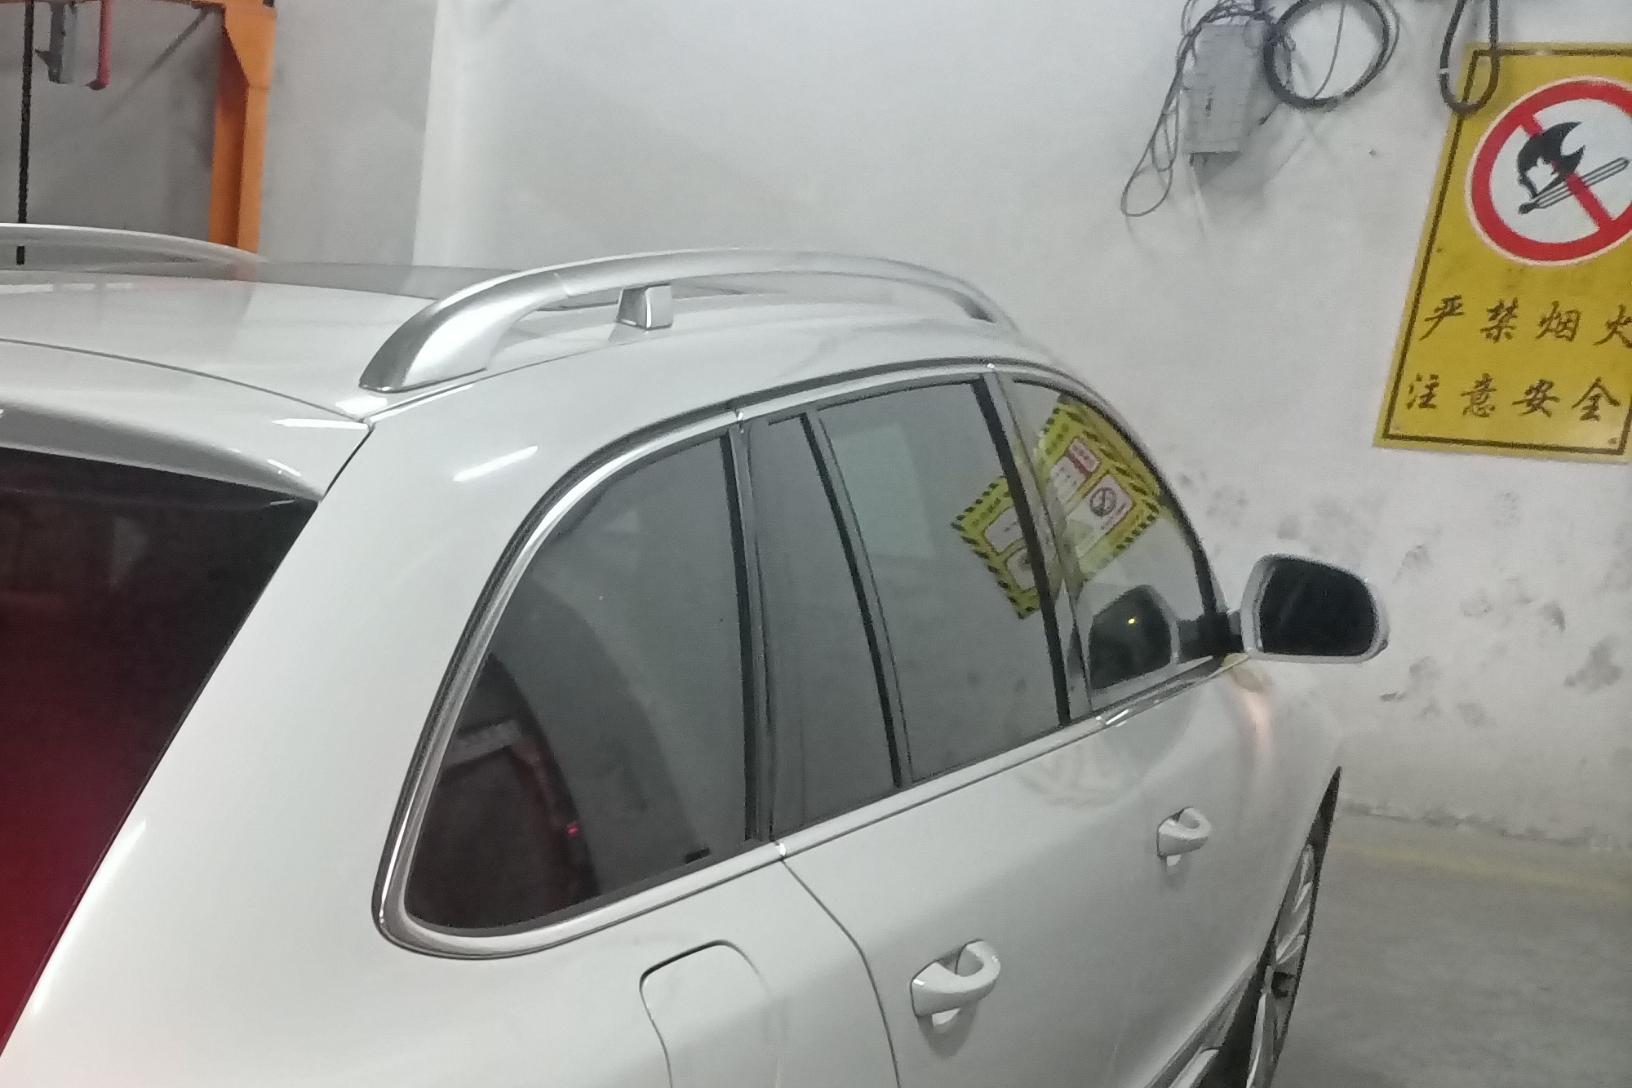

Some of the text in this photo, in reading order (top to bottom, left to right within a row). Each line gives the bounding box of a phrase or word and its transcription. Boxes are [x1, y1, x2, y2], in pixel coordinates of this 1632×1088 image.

[1419, 295, 1632, 349] 严禁烟火
[1407, 373, 1621, 422] 注意安全
